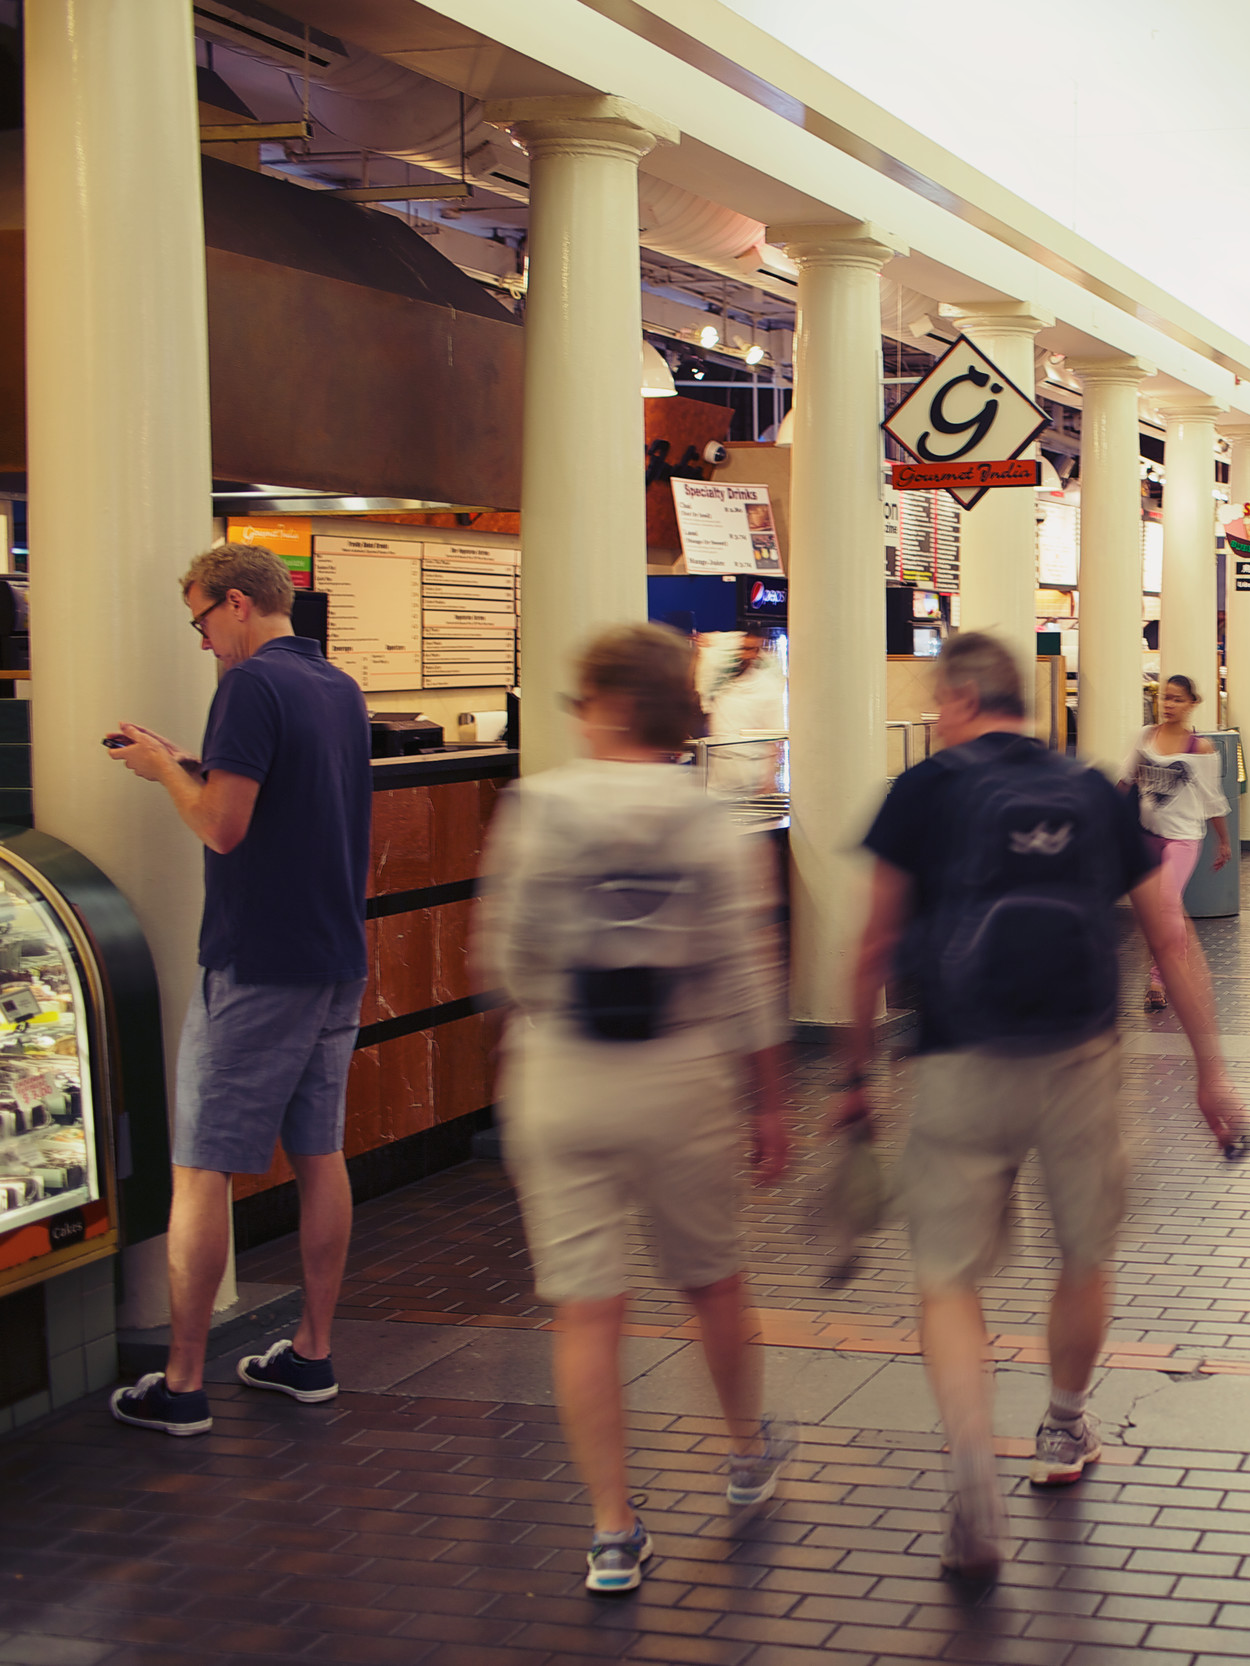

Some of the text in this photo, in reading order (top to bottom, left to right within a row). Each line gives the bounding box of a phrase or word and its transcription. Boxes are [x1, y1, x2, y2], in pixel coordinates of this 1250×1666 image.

[896, 462, 1033, 487] Gourmet India
[684, 484, 758, 502] Specialty Drinks
